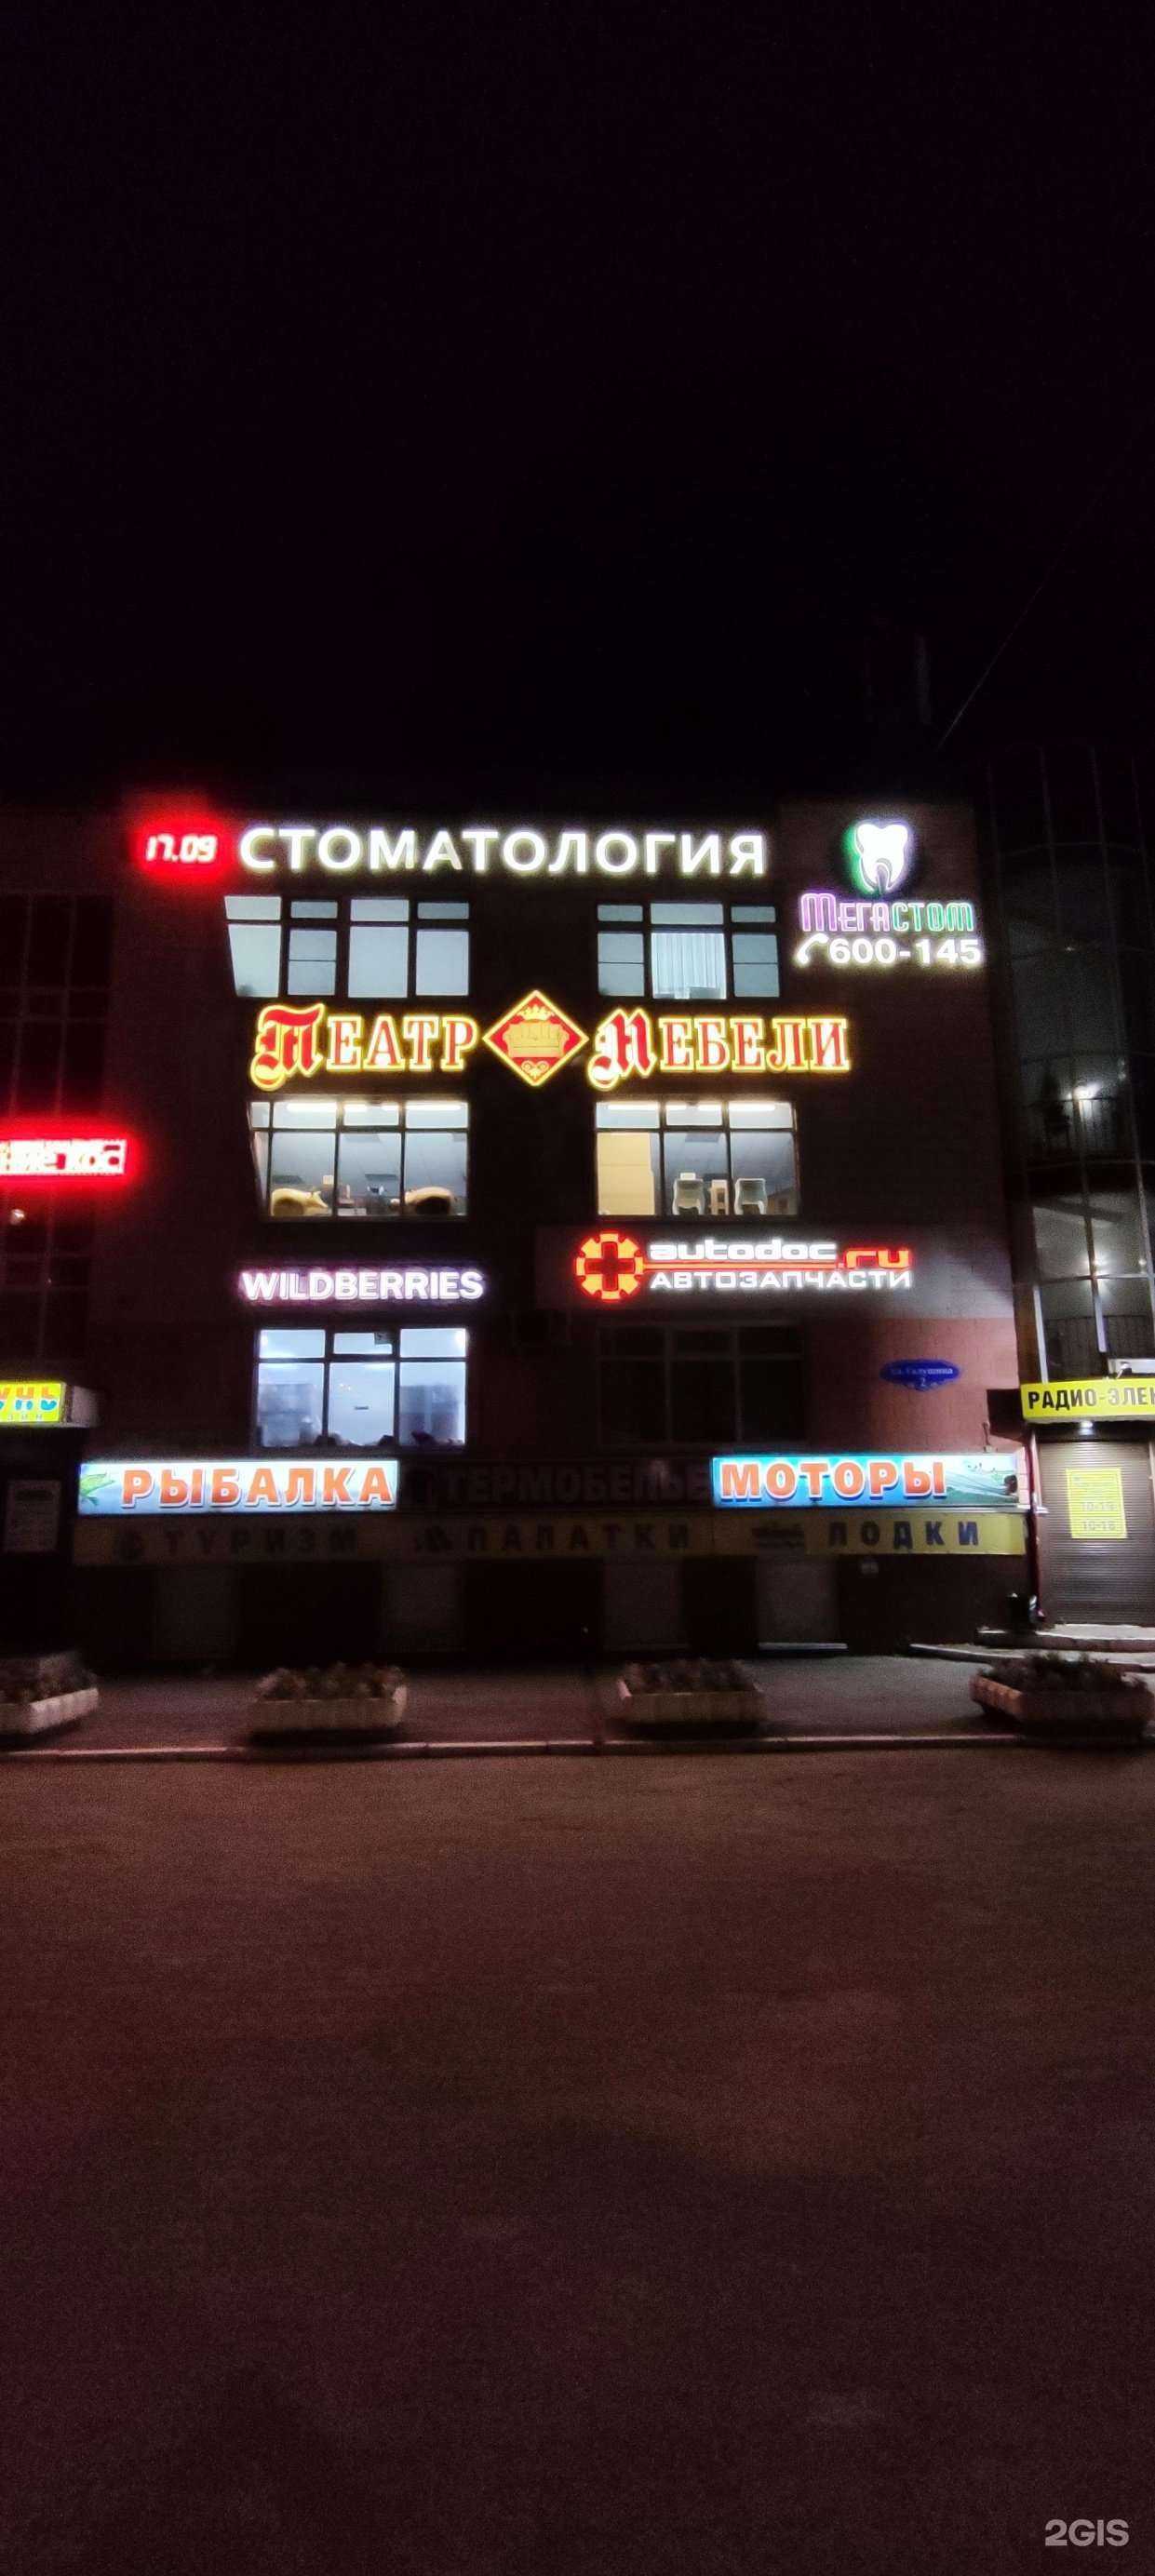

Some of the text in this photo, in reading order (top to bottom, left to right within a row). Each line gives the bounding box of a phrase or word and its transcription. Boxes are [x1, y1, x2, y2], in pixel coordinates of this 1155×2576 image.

[145, 834, 218, 863] 17.09
[239, 827, 766, 875] СТОМАТОЛОГИЯ
[829, 937, 982, 964] 600-145
[250, 1003, 852, 1092] ТЕАТР МЕБЕЛИ
[649, 1239, 910, 1268] autodoc.ru
[240, 1270, 484, 1301] WILDBERRIES
[649, 1269, 912, 1290] АВТОЗАПЧАСТИ
[121, 1467, 395, 1509] РЫБАЛКА
[720, 1460, 947, 1500] МОТОРЫ
[164, 1528, 358, 1554] ТУРИЗМ
[469, 1523, 690, 1551] ПАЛАТКИ
[828, 1520, 978, 1550] ЛОДКИ
